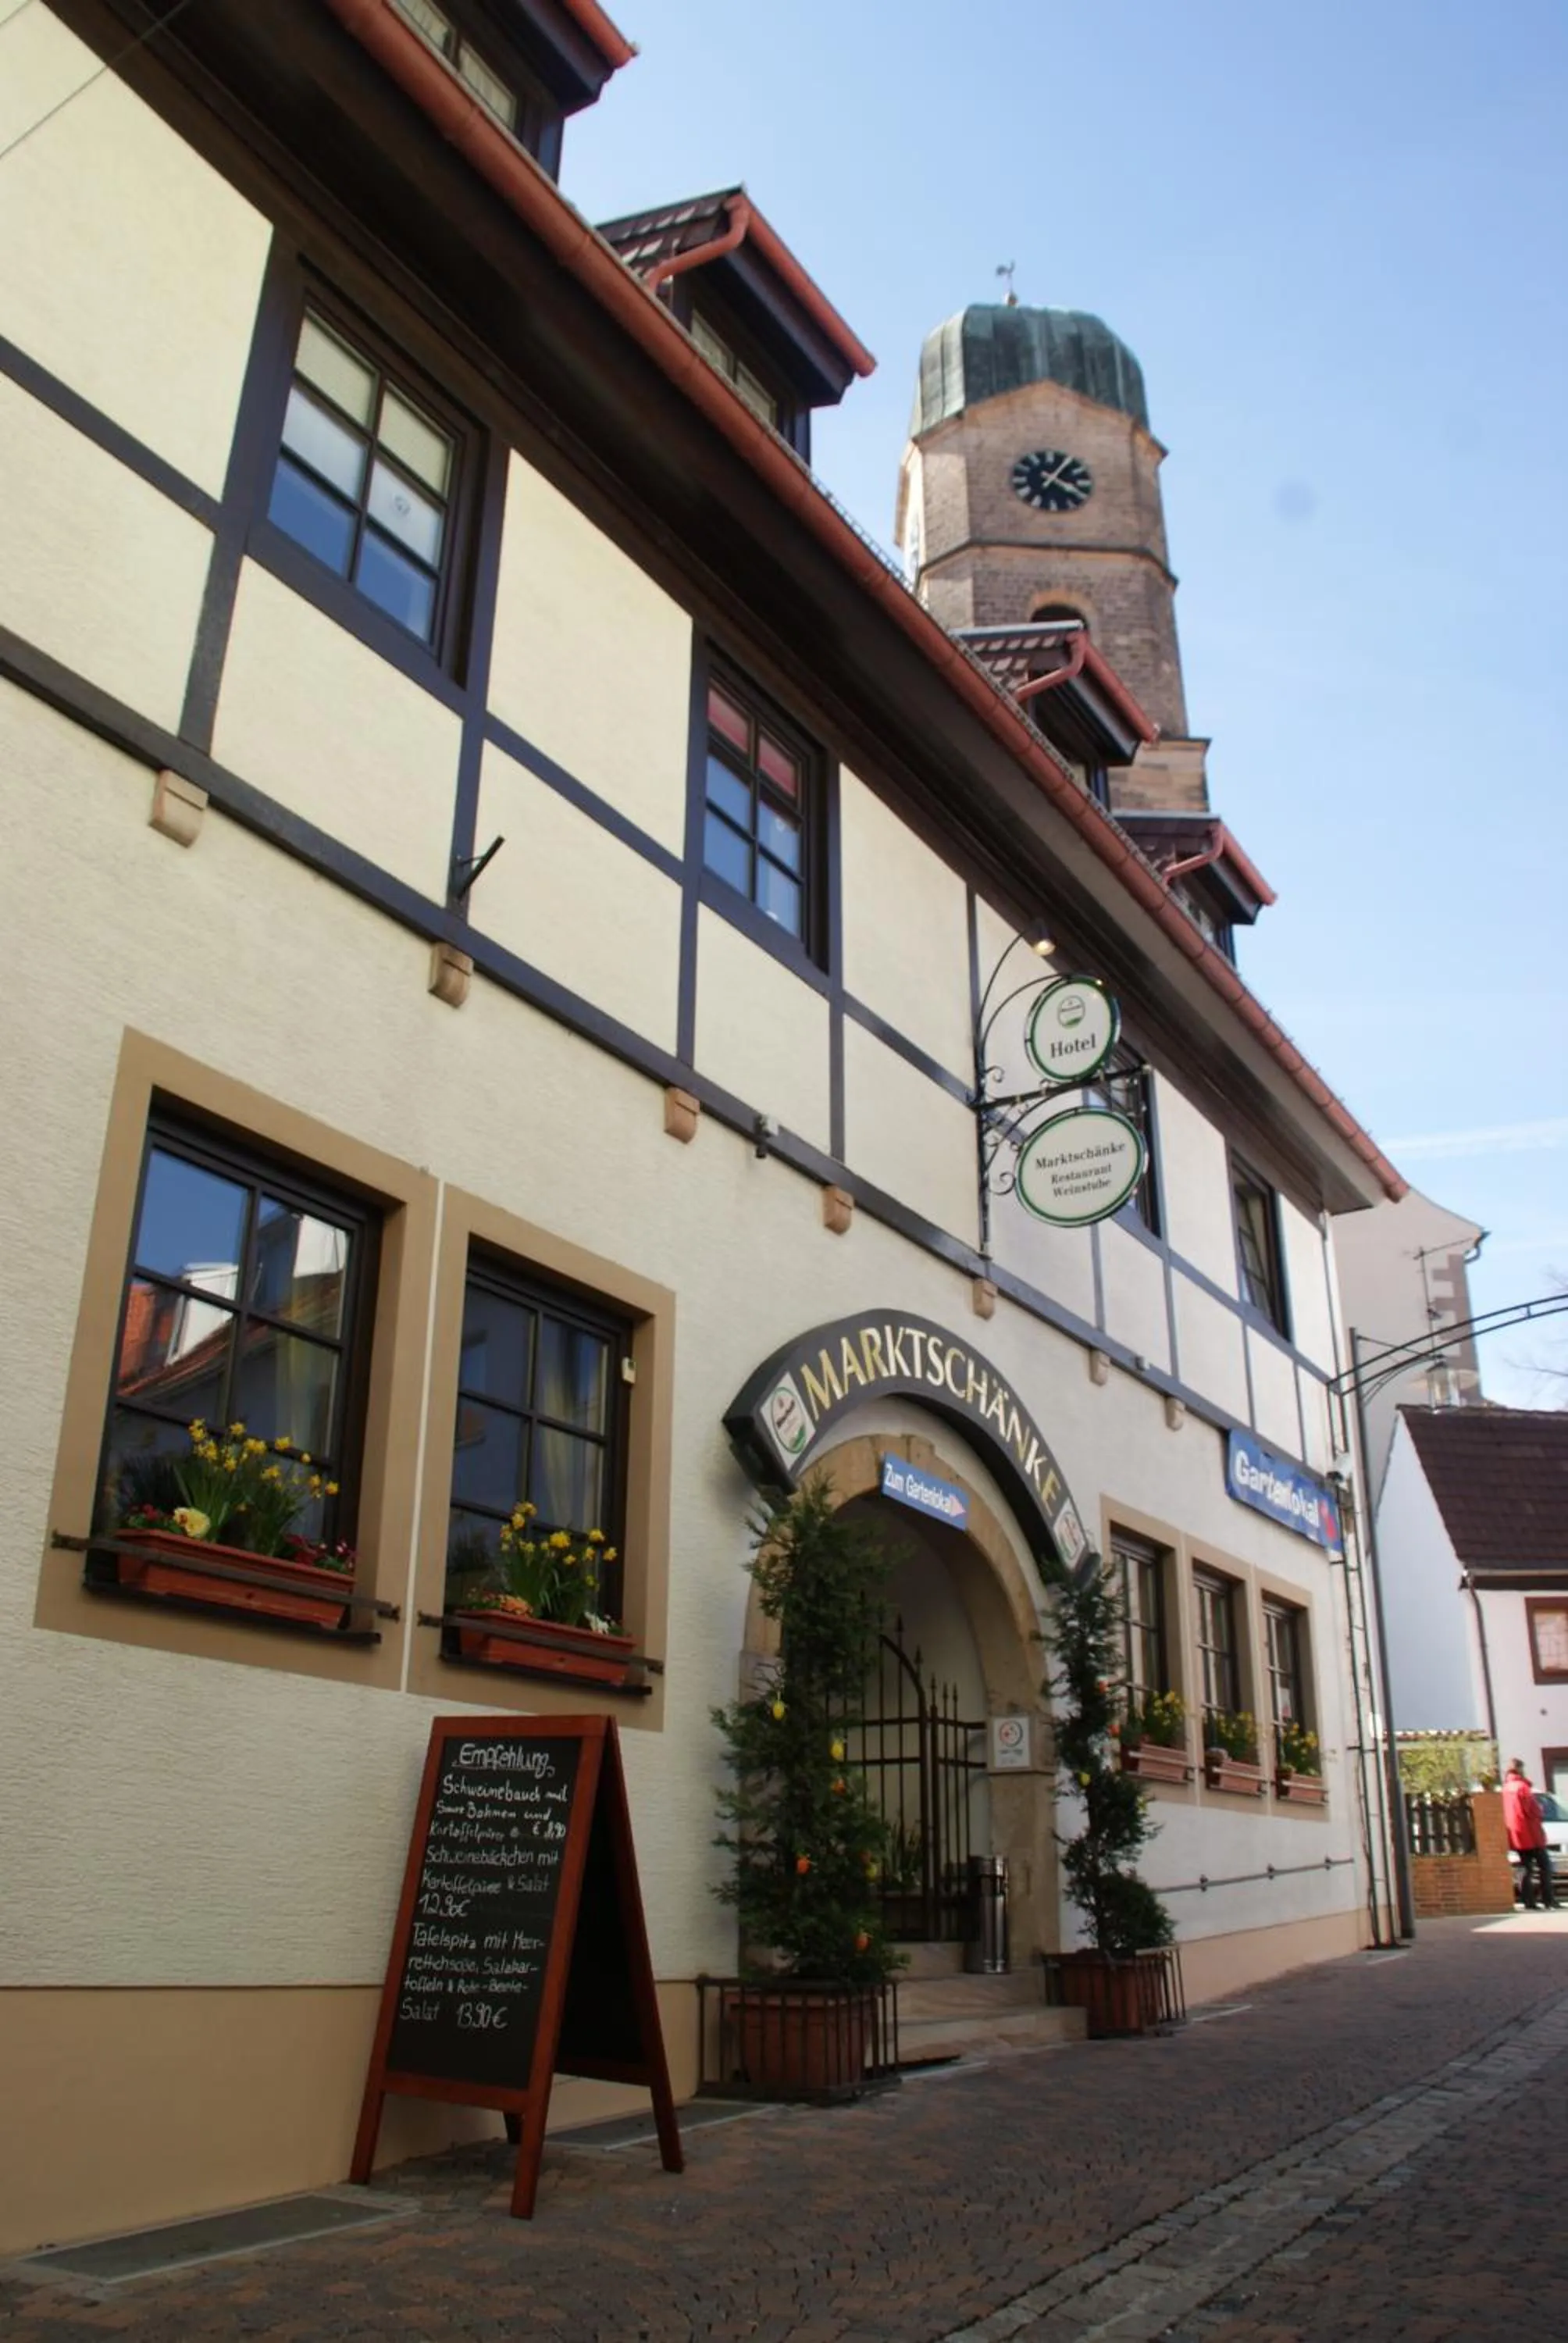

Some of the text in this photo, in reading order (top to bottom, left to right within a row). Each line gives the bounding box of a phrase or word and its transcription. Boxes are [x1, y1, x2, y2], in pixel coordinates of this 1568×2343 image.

[1050, 1032, 1096, 1058] Hotel
[1035, 1142, 1126, 1169] Marktschänke
[1051, 1162, 1112, 1185] Restaurant
[1053, 1178, 1111, 1197] Weinstube
[800, 1325, 1060, 1517] MARKTSCHÄNKE
[884, 1462, 905, 1493] Zum
[458, 1742, 551, 1780] Empfehlung
[442, 1774, 568, 1802] Schweinebauch mit
[466, 1801, 517, 1819] Bohnen
[524, 1806, 552, 1821] und
[537, 1849, 559, 1866] mit
[516, 1874, 550, 1892] Salat
[413, 1922, 476, 1951] Tafelspitz
[483, 1930, 508, 1949] mit
[399, 1997, 440, 2021] Salat
